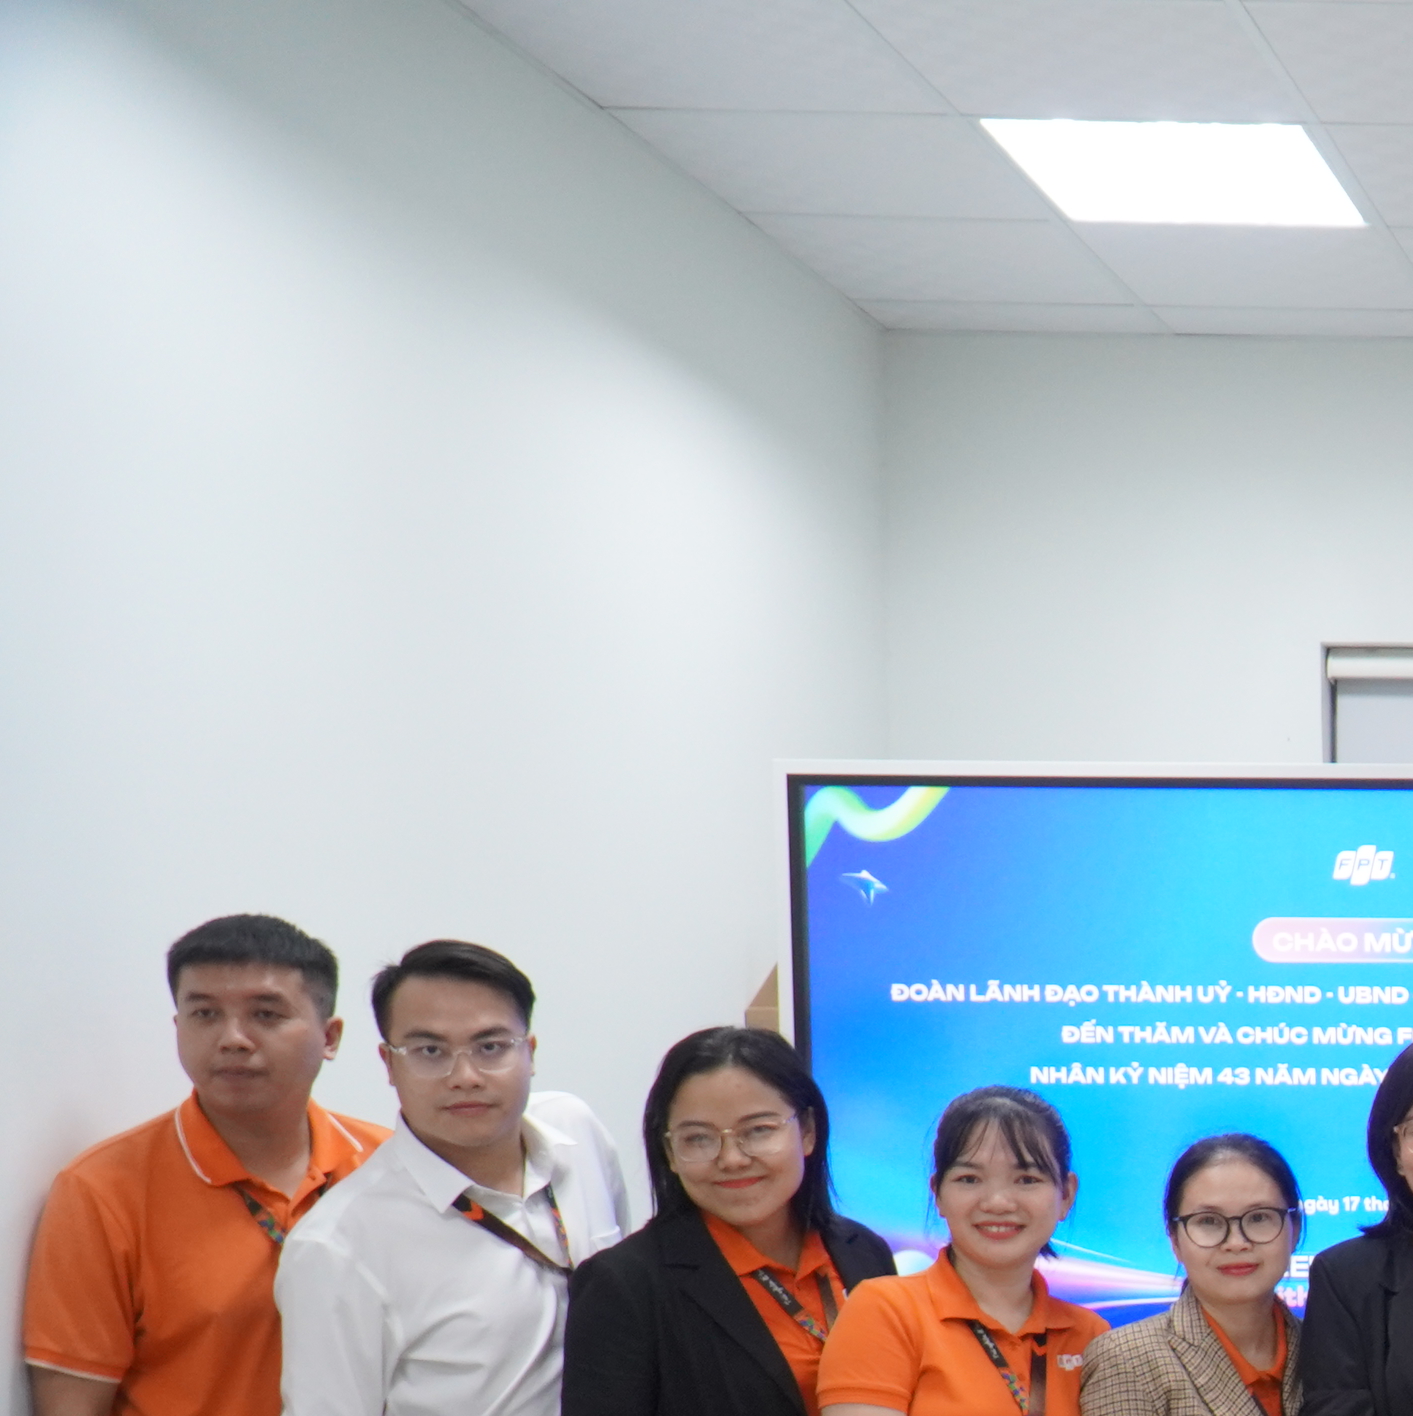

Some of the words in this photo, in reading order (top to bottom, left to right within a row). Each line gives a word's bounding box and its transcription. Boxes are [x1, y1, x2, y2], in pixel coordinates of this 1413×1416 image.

[1332, 844, 1394, 886] FPT
[1272, 927, 1359, 954] CHÀO
[891, 979, 965, 1002] ĐOÀN
[969, 979, 1040, 1002] LÃNH
[1045, 984, 1100, 1007] ĐẠO
[1102, 980, 1192, 1003] THÀNH
[1249, 985, 1322, 1004] HĐND
[1338, 986, 1410, 1004] UBND
[1061, 1019, 1115, 1043] ĐẾN
[1117, 1021, 1195, 1044] THĂM
[1198, 1021, 1234, 1044] VÀ
[1236, 1021, 1309, 1045] CHÚC
[1312, 1023, 1393, 1045] MỪNG
[1030, 1062, 1105, 1085] NHÂN
[1148, 1062, 1213, 1089] NIỆM
[1217, 1067, 1251, 1085] 43
[1255, 1063, 1316, 1086] NĂM
[1300, 1195, 1340, 1216] gày
[1343, 1196, 1361, 1212] 17
